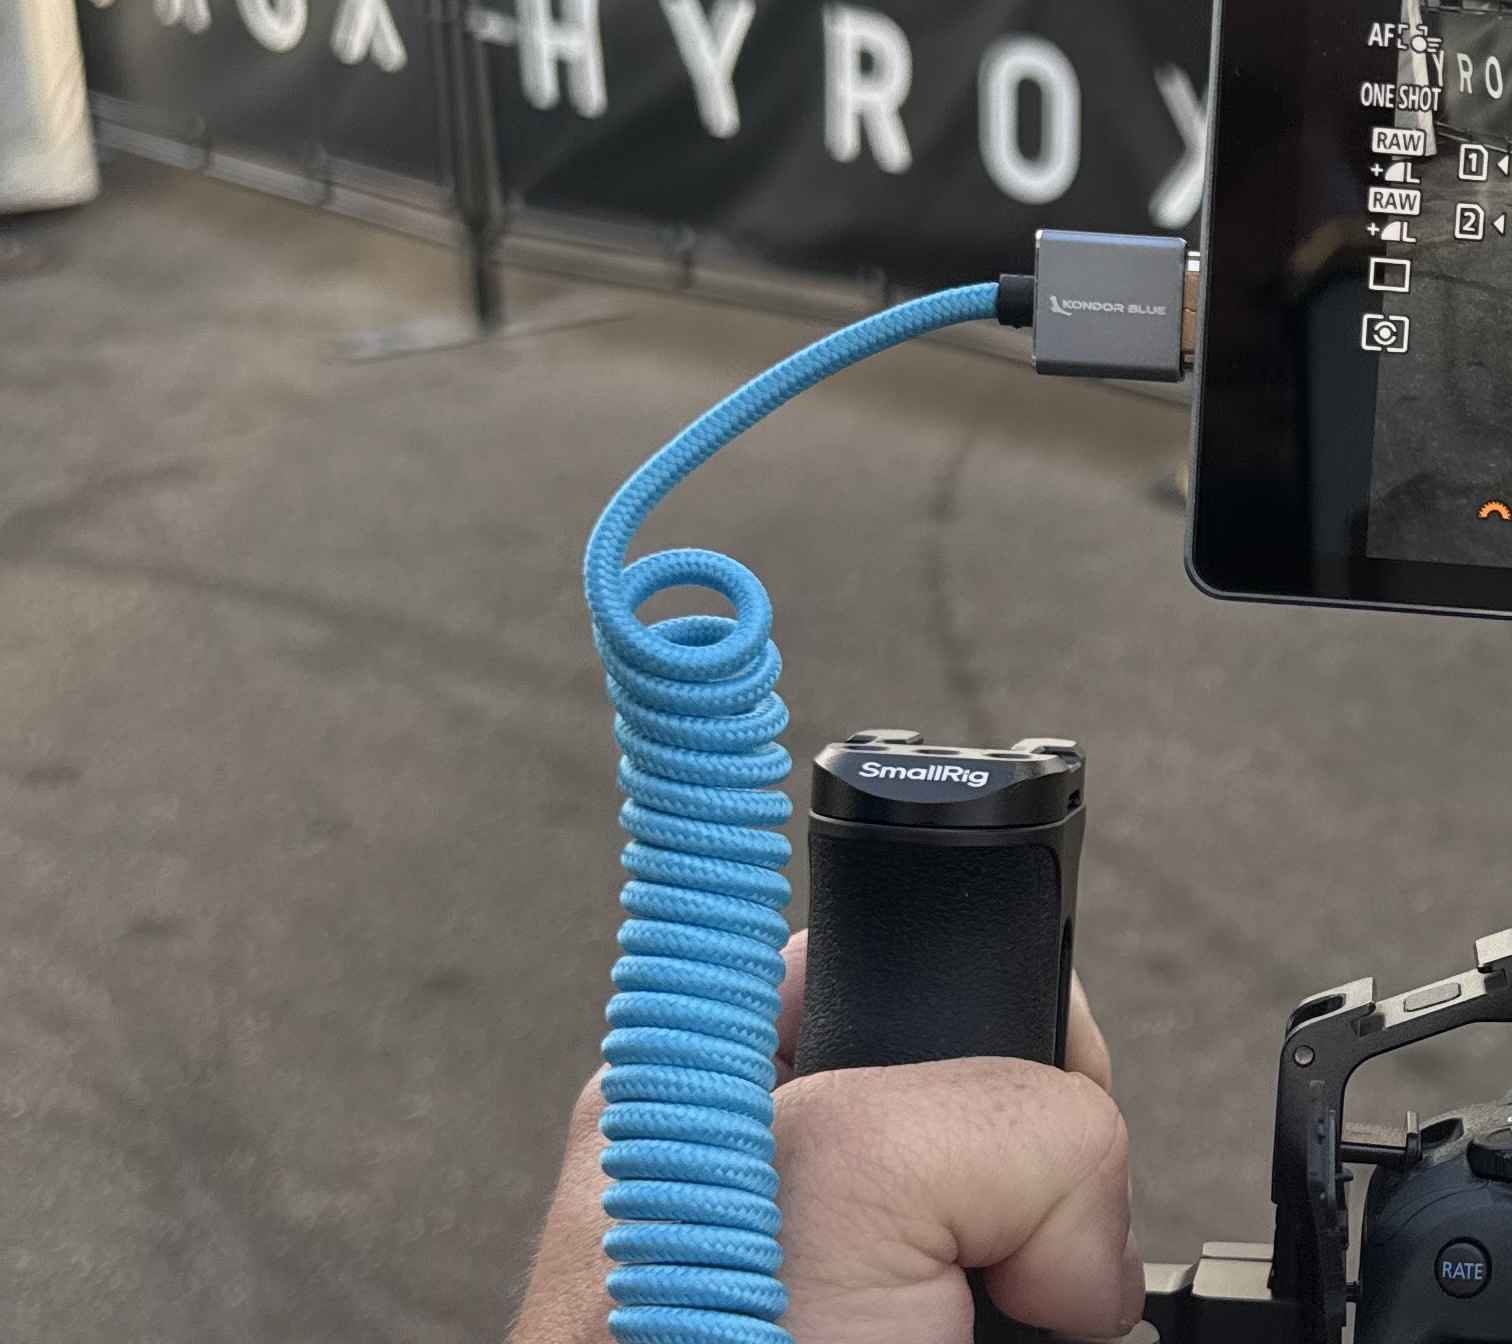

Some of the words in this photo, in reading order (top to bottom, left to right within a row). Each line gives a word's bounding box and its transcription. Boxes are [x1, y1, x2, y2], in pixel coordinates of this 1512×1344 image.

[1360, 82, 1394, 109] ONE
[1398, 86, 1442, 112] SHOT
[1376, 131, 1421, 152] RAW
[1373, 191, 1418, 213] RAW
[1062, 299, 1125, 313] KONDOR
[1127, 304, 1167, 316] BLUE
[858, 761, 990, 788] SmallRig
[1441, 1260, 1484, 1282] RATE
